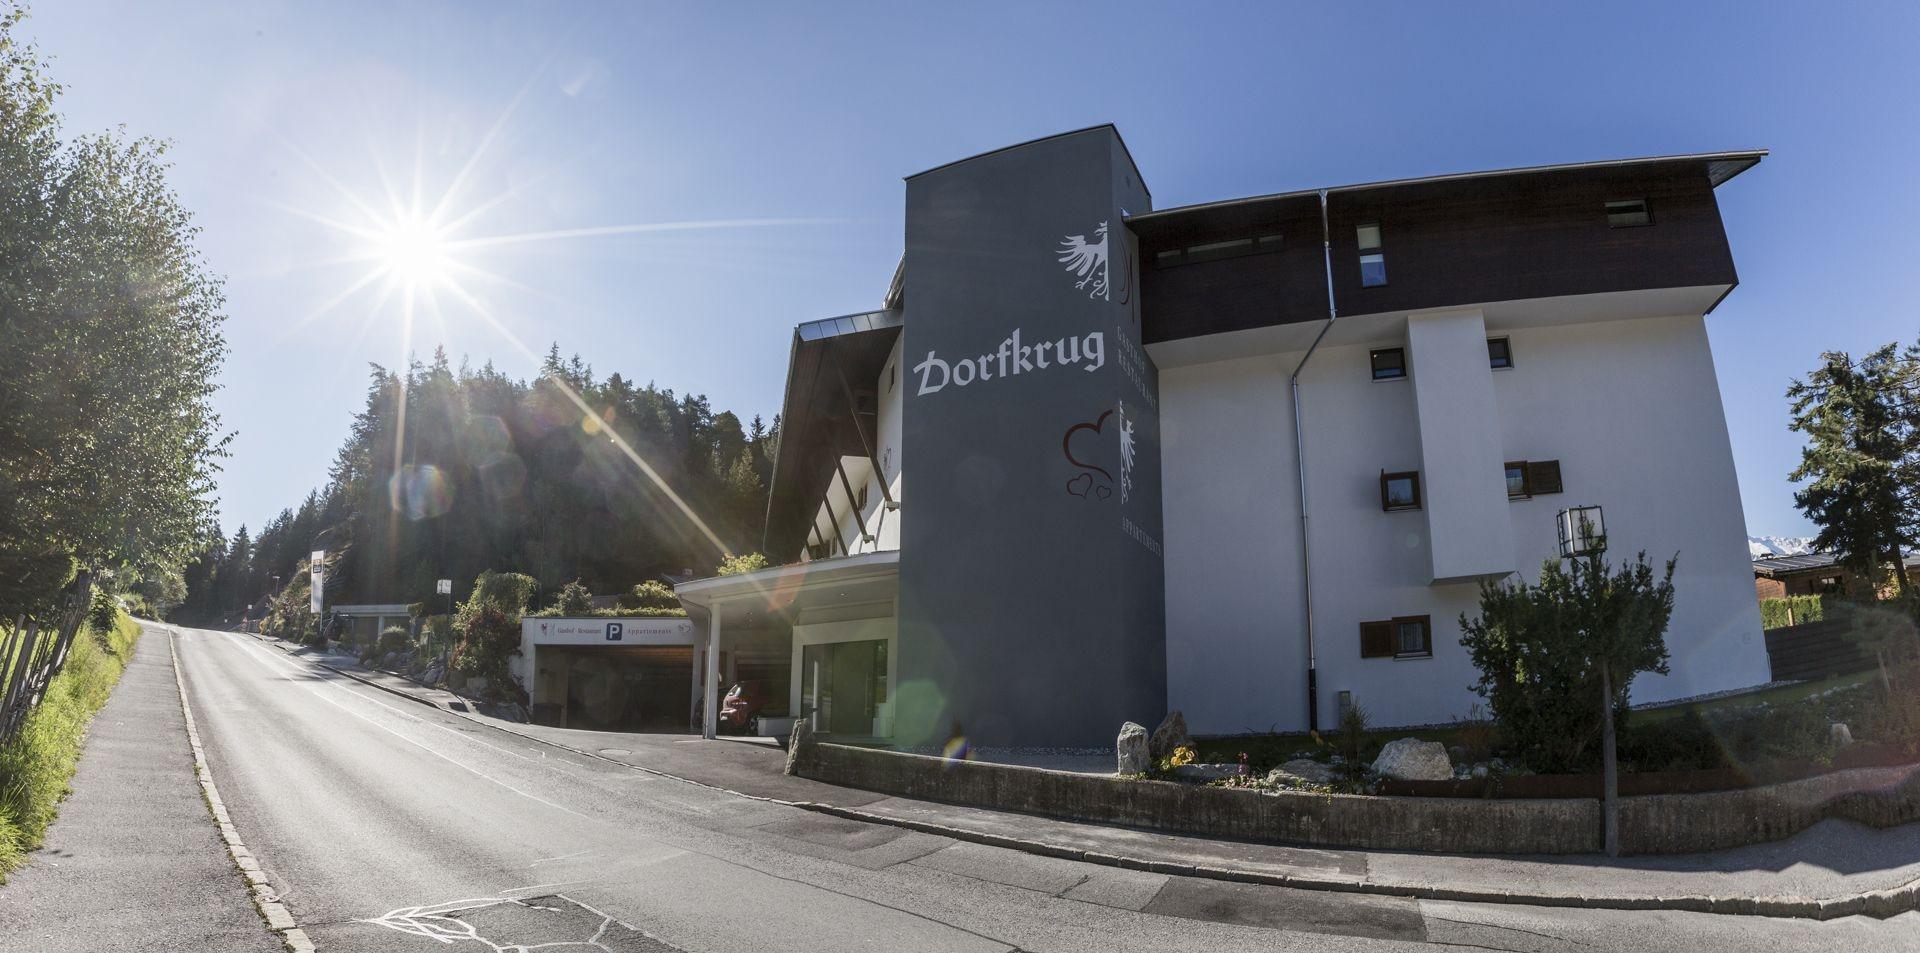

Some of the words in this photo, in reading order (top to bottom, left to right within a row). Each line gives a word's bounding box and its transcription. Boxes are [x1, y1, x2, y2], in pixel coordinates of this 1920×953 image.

[913, 327, 1105, 397] Dorfkrug
[1118, 349, 1157, 411] RESTAURANT
[1121, 515, 1161, 557] APPARTEMENTS
[609, 624, 619, 639] P
[627, 628, 672, 636] Appartements
